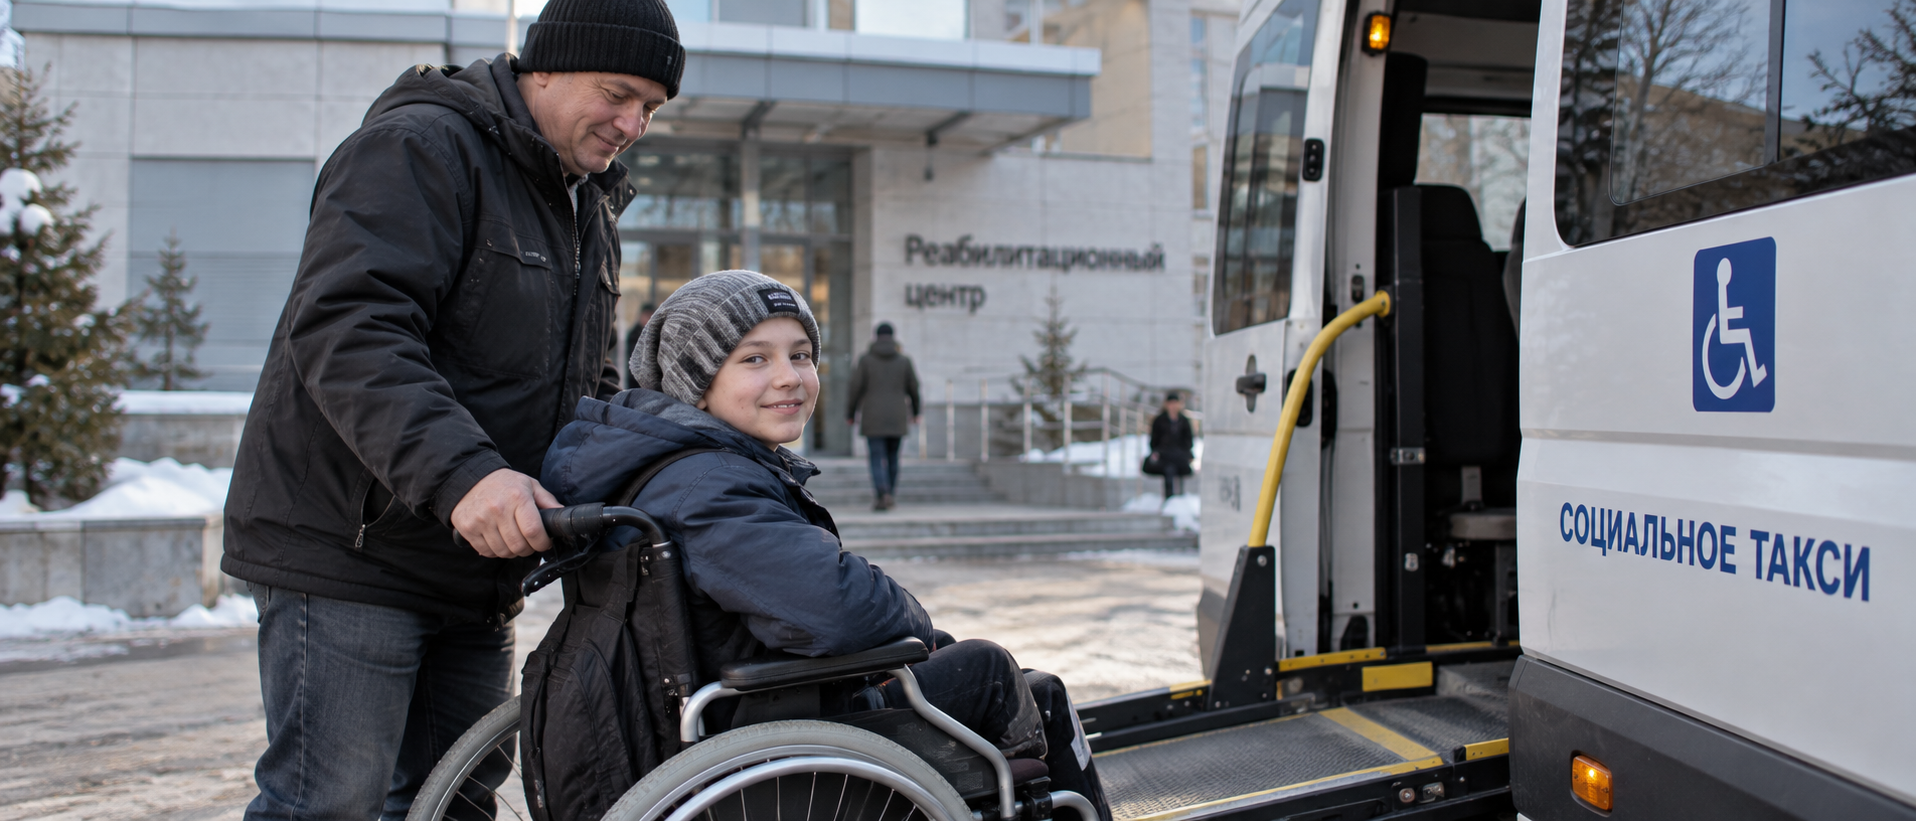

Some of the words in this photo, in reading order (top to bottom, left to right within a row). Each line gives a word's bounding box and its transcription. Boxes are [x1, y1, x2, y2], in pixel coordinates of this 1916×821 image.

[904, 234, 1164, 272] Реабилитационный
[905, 285, 986, 314] центр
[1560, 502, 1737, 574] СОЦИАЛЬНОЕ
[1750, 529, 1871, 602] ТАКСИ
